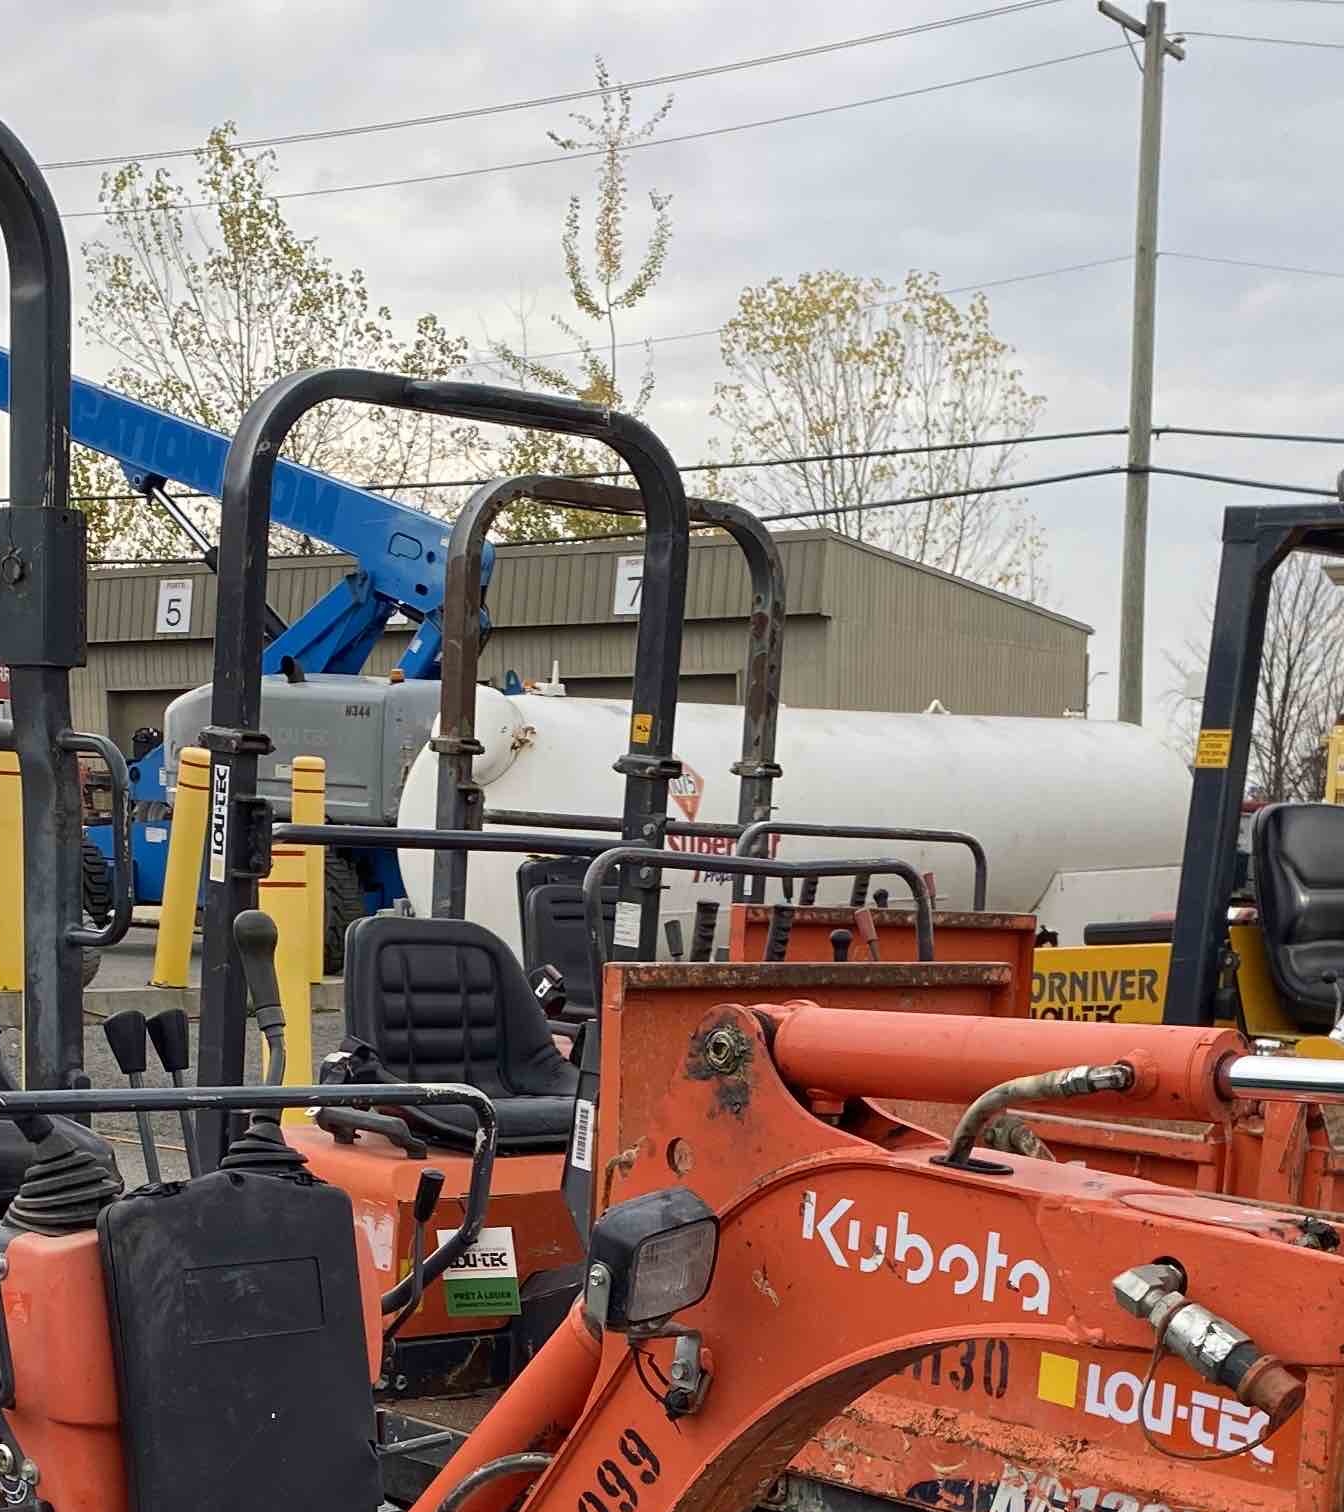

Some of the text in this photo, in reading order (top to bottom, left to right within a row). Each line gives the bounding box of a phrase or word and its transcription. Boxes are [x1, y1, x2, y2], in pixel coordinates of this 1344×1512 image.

[166, 598, 181, 626] 5
[1030, 968, 1160, 1006] ORNIVER
[799, 1189, 1051, 1317] Kubota
[1084, 1362, 1275, 1466] LOU-TEC
